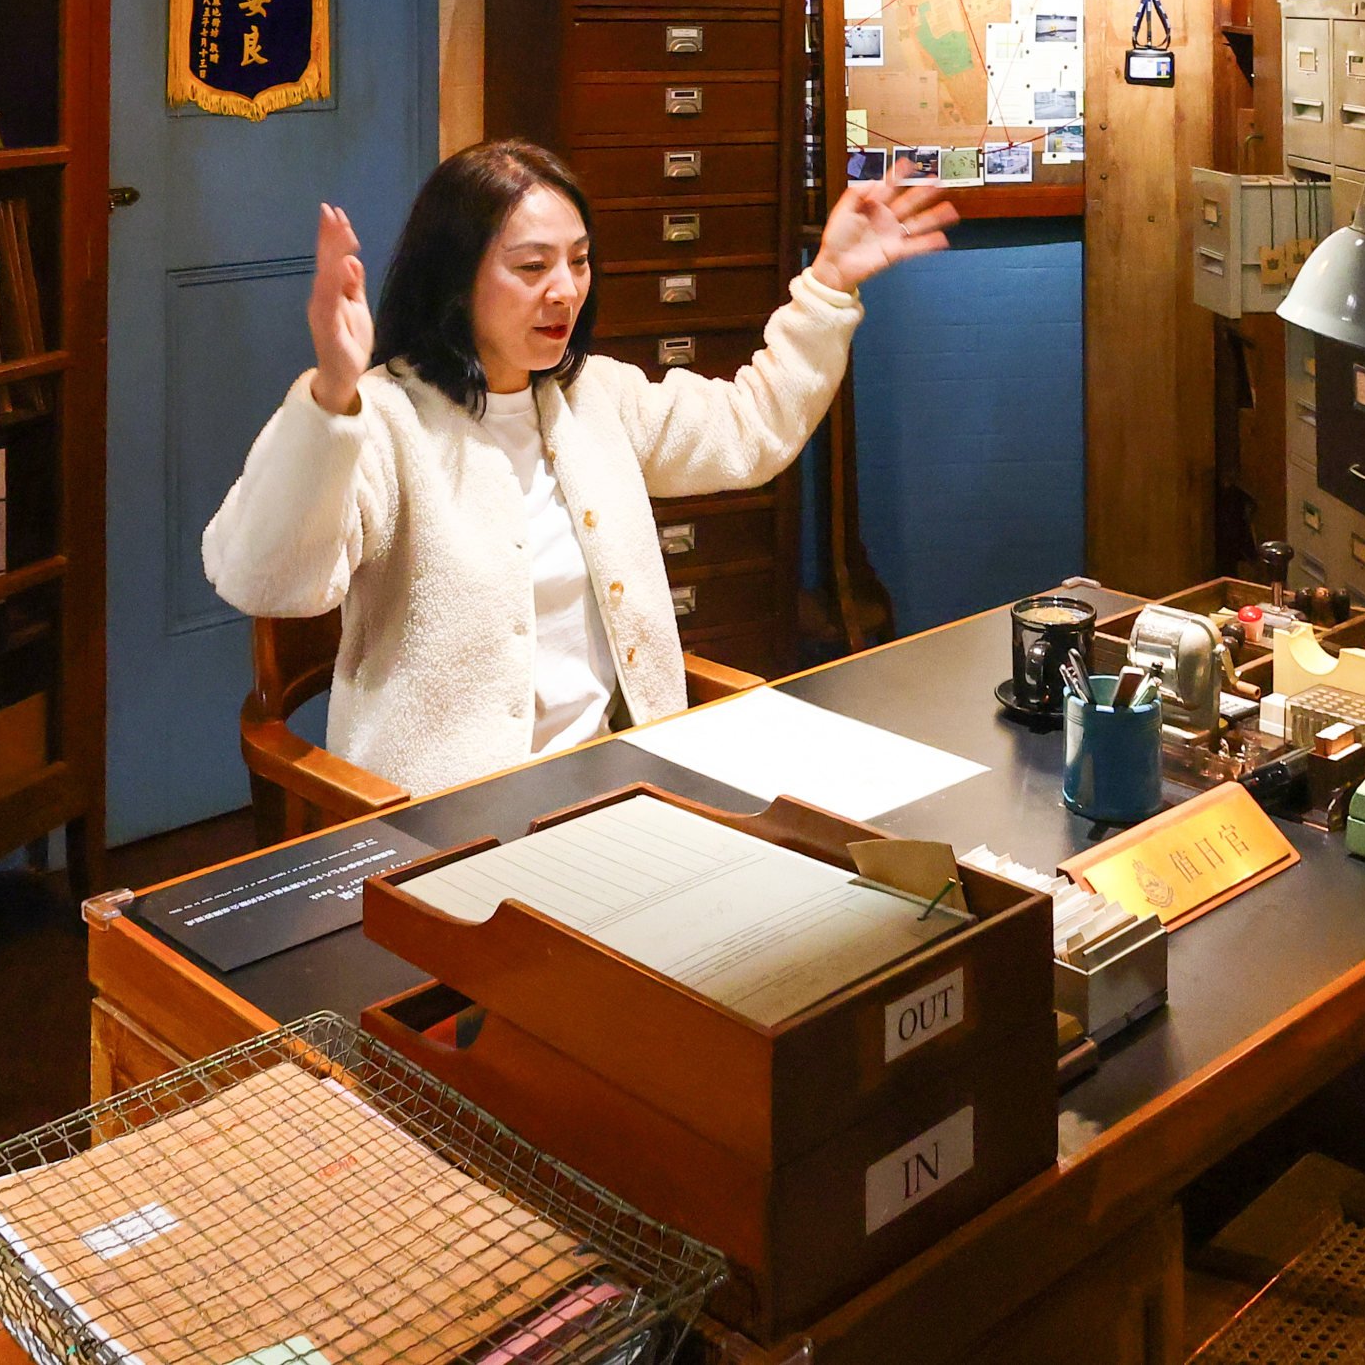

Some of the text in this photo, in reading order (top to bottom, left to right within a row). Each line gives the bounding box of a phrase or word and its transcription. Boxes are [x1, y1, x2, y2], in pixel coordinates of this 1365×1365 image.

[1168, 823, 1251, 883] 值日官
[897, 984, 955, 1042] OUT
[901, 1143, 941, 1201] IN
